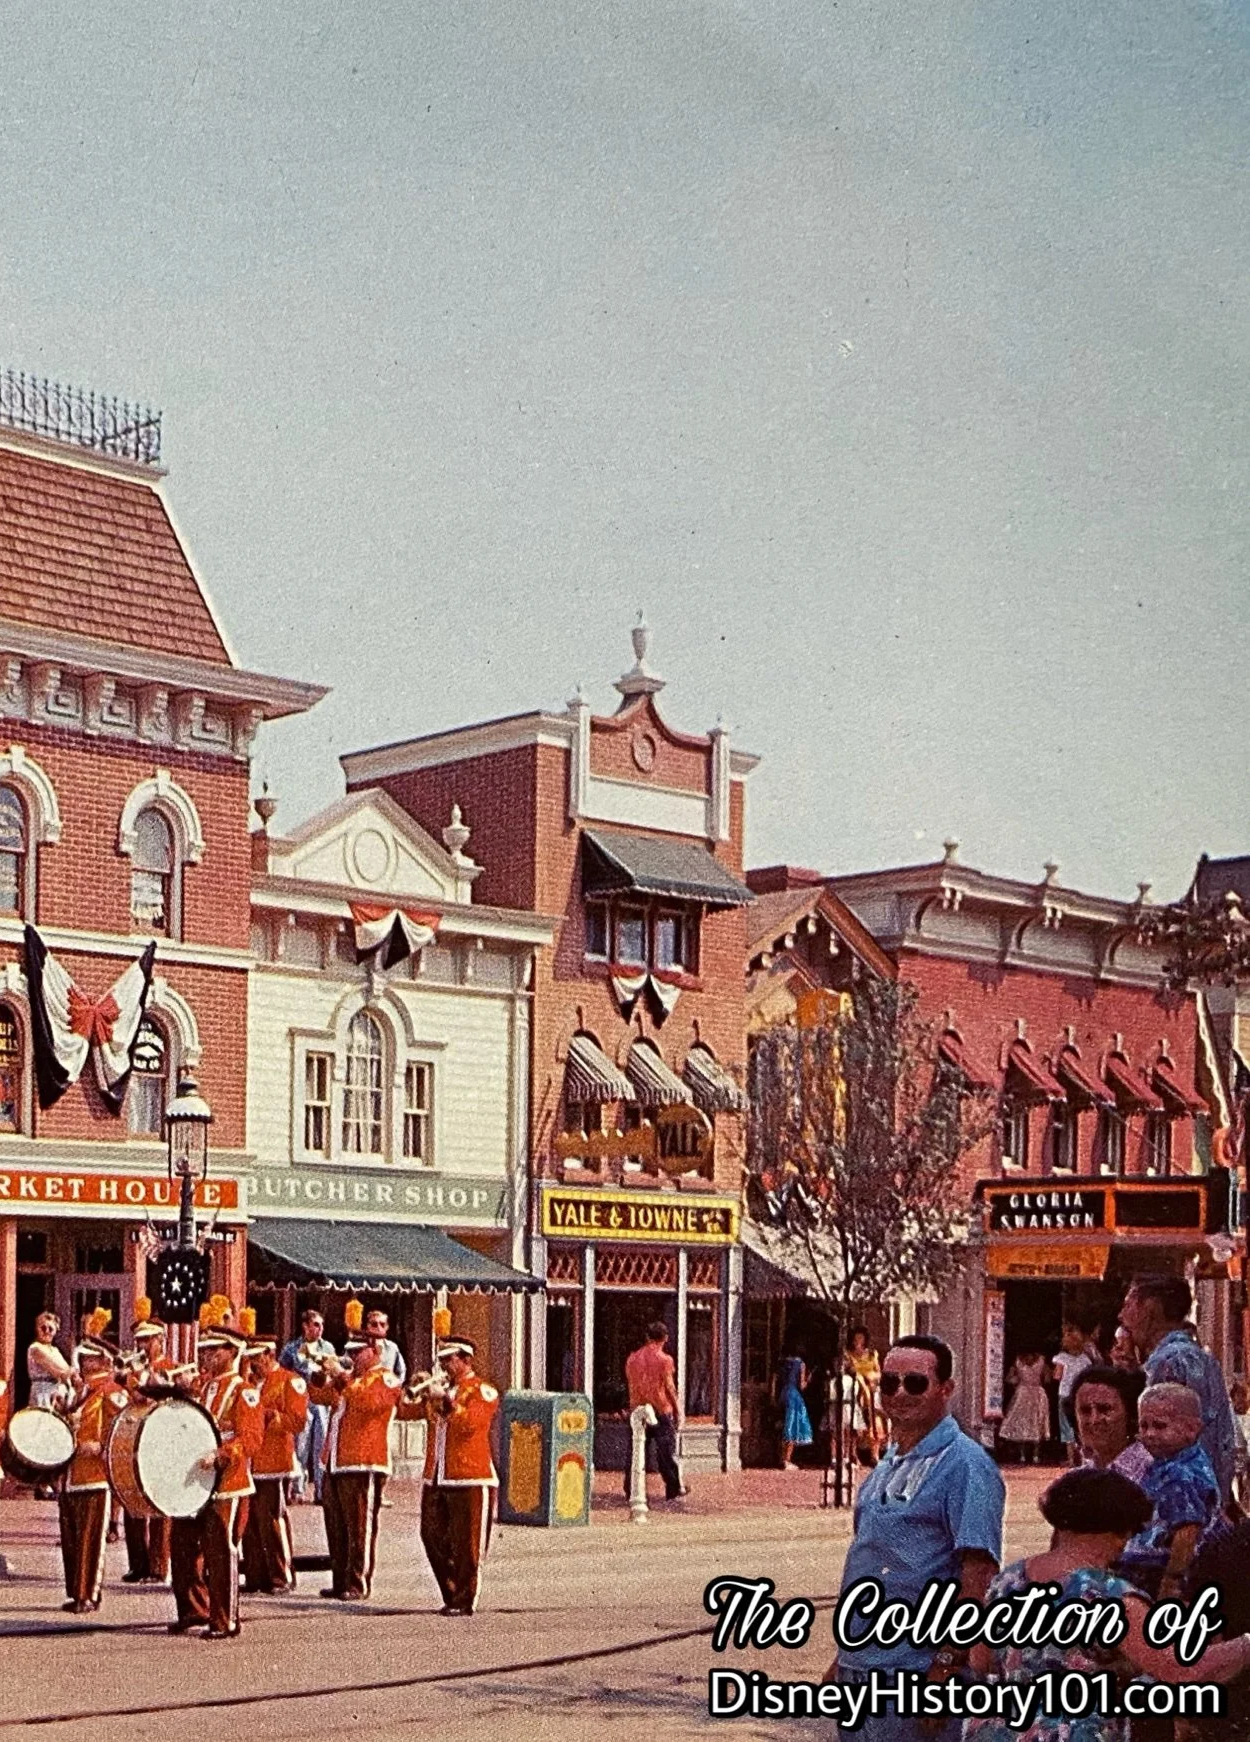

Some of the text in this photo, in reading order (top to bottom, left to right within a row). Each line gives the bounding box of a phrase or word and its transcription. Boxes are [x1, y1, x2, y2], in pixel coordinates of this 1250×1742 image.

[99, 1178, 222, 1205] HOUE
[248, 1178, 488, 1209] BUTCHER SHOP
[1009, 1191, 1083, 1209] GLORIA
[553, 1202, 602, 1227] YALE
[609, 1208, 623, 1228] &
[629, 1207, 698, 1231] TOWNE
[1000, 1212, 1095, 1231] SWANSON
